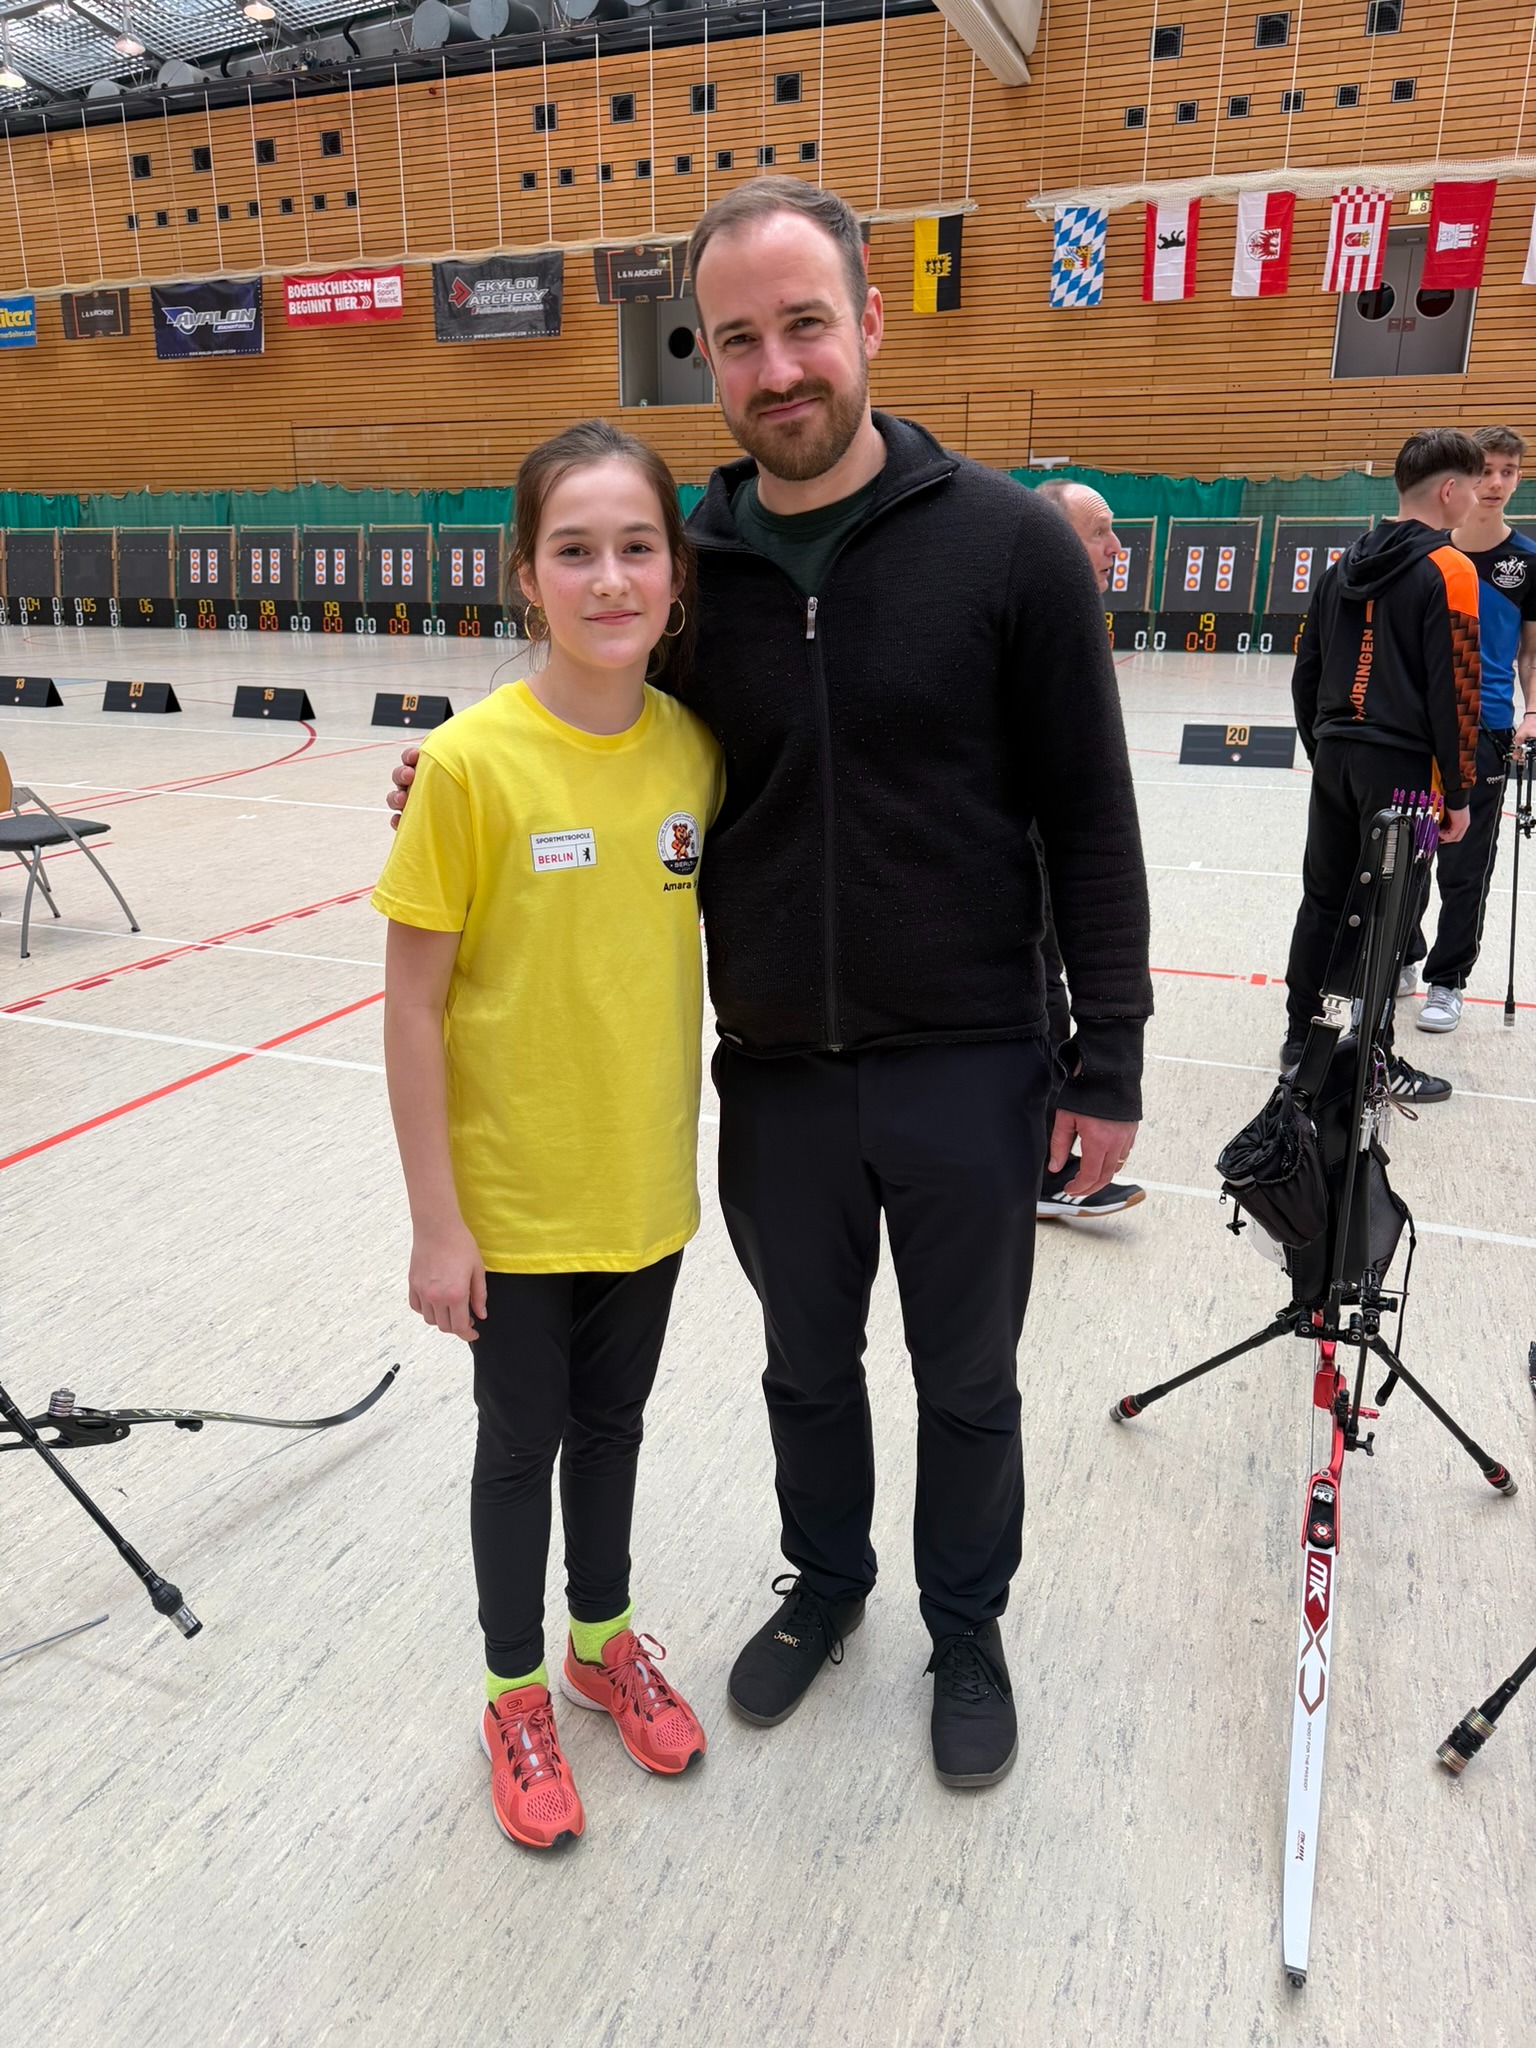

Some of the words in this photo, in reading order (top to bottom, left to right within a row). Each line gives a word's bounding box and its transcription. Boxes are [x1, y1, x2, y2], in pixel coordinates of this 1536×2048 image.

[1420, 202, 1427, 212] 8
[617, 271, 622, 279] L
[622, 270, 628, 278] &
[628, 270, 634, 278] N
[634, 268, 663, 277] ARCHERY
[287, 279, 371, 299] BOGENSCHIESSEN
[476, 280, 537, 292] SKYLON
[289, 298, 331, 315] BEGINNT
[334, 296, 361, 311] HIER.
[470, 291, 545, 306] ARCHERY
[173, 308, 257, 327] AVALON
[27, 597, 41, 612] 04
[82, 597, 97, 613] 05
[139, 599, 154, 614] 06
[199, 599, 214, 615] 07
[260, 600, 276, 615] 08
[324, 601, 340, 617] 09
[465, 605, 478, 620] 11
[1199, 613, 1215, 632] 19
[15, 678, 25, 689] 13
[264, 688, 275, 701] 15
[405, 696, 416, 709] 16
[1229, 727, 1247, 742] 20
[536, 832, 591, 845] SPORTMETROPOLE
[538, 852, 574, 865] BERLIN
[663, 881, 691, 892] Amara
[1308, 1557, 1329, 1612] MK
